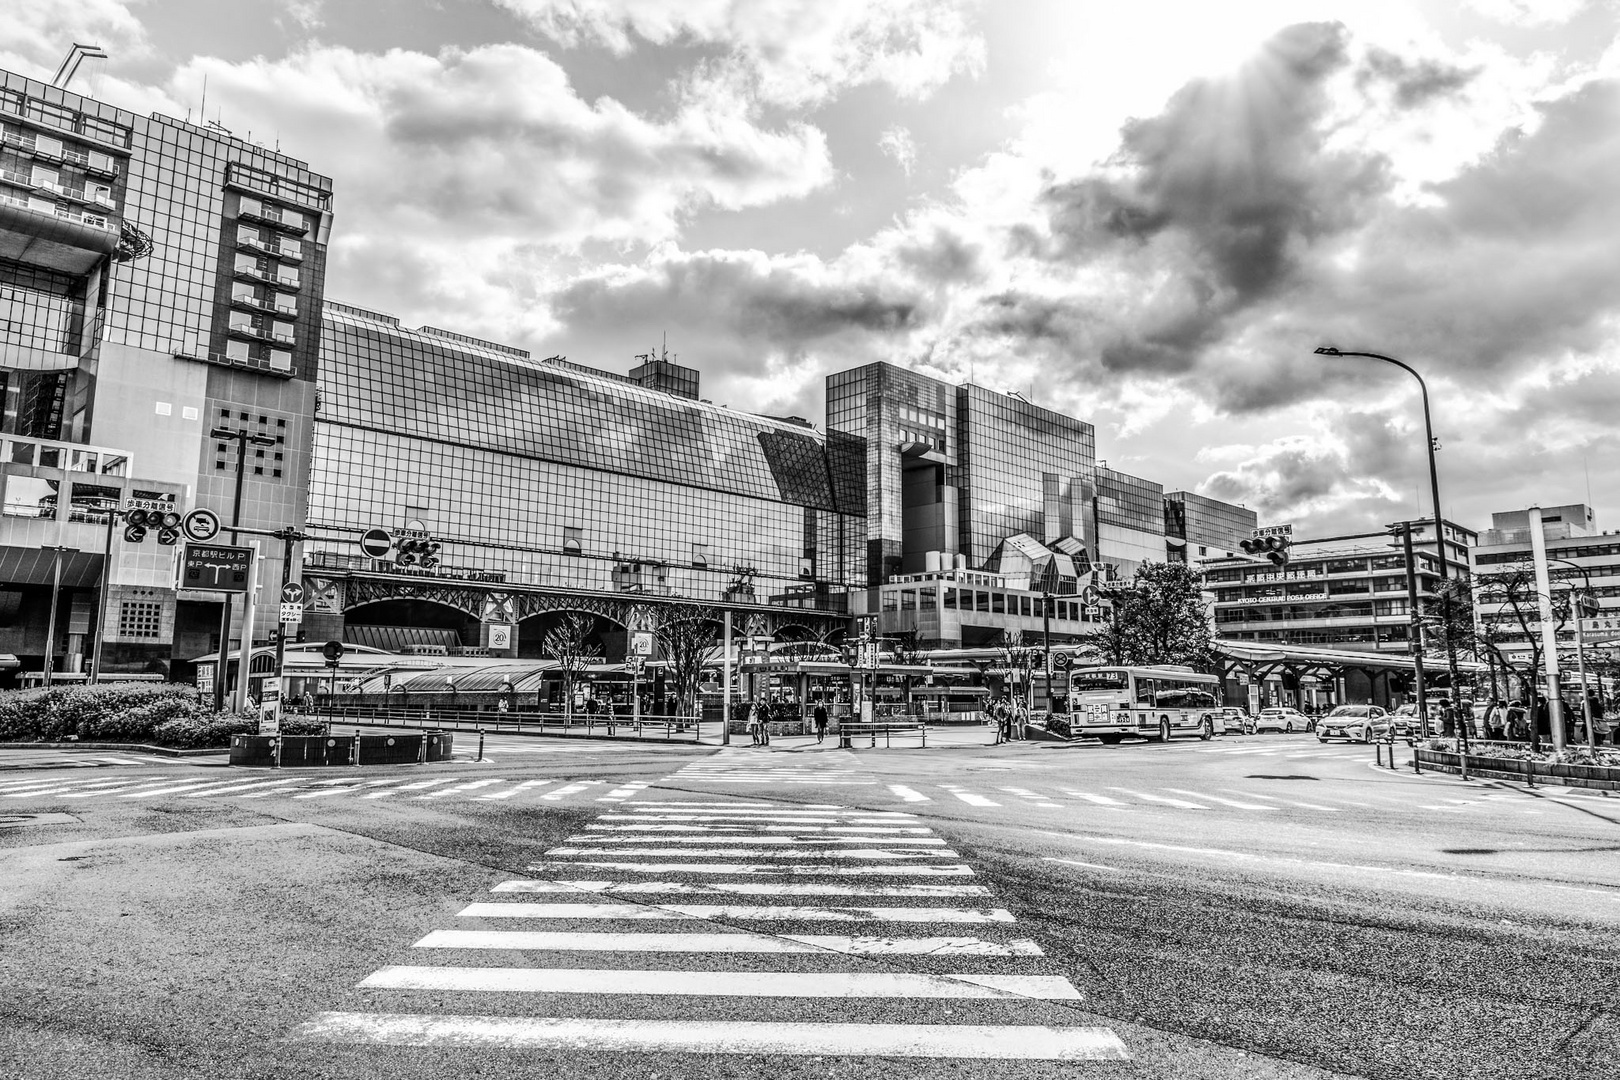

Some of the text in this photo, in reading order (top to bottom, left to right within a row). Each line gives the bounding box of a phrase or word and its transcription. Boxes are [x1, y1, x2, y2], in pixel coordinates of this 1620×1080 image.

[127, 499, 174, 511] 歩車分離信号
[395, 529, 428, 539] 歩車分離信号
[1252, 526, 1290, 537] 歩車分離信号
[192, 549, 245, 560] 京都駅ビル P
[232, 563, 247, 571] 西P
[1258, 595, 1286, 603] CENTRAL
[1286, 594, 1304, 602] POST
[1305, 592, 1327, 600] OFFICE
